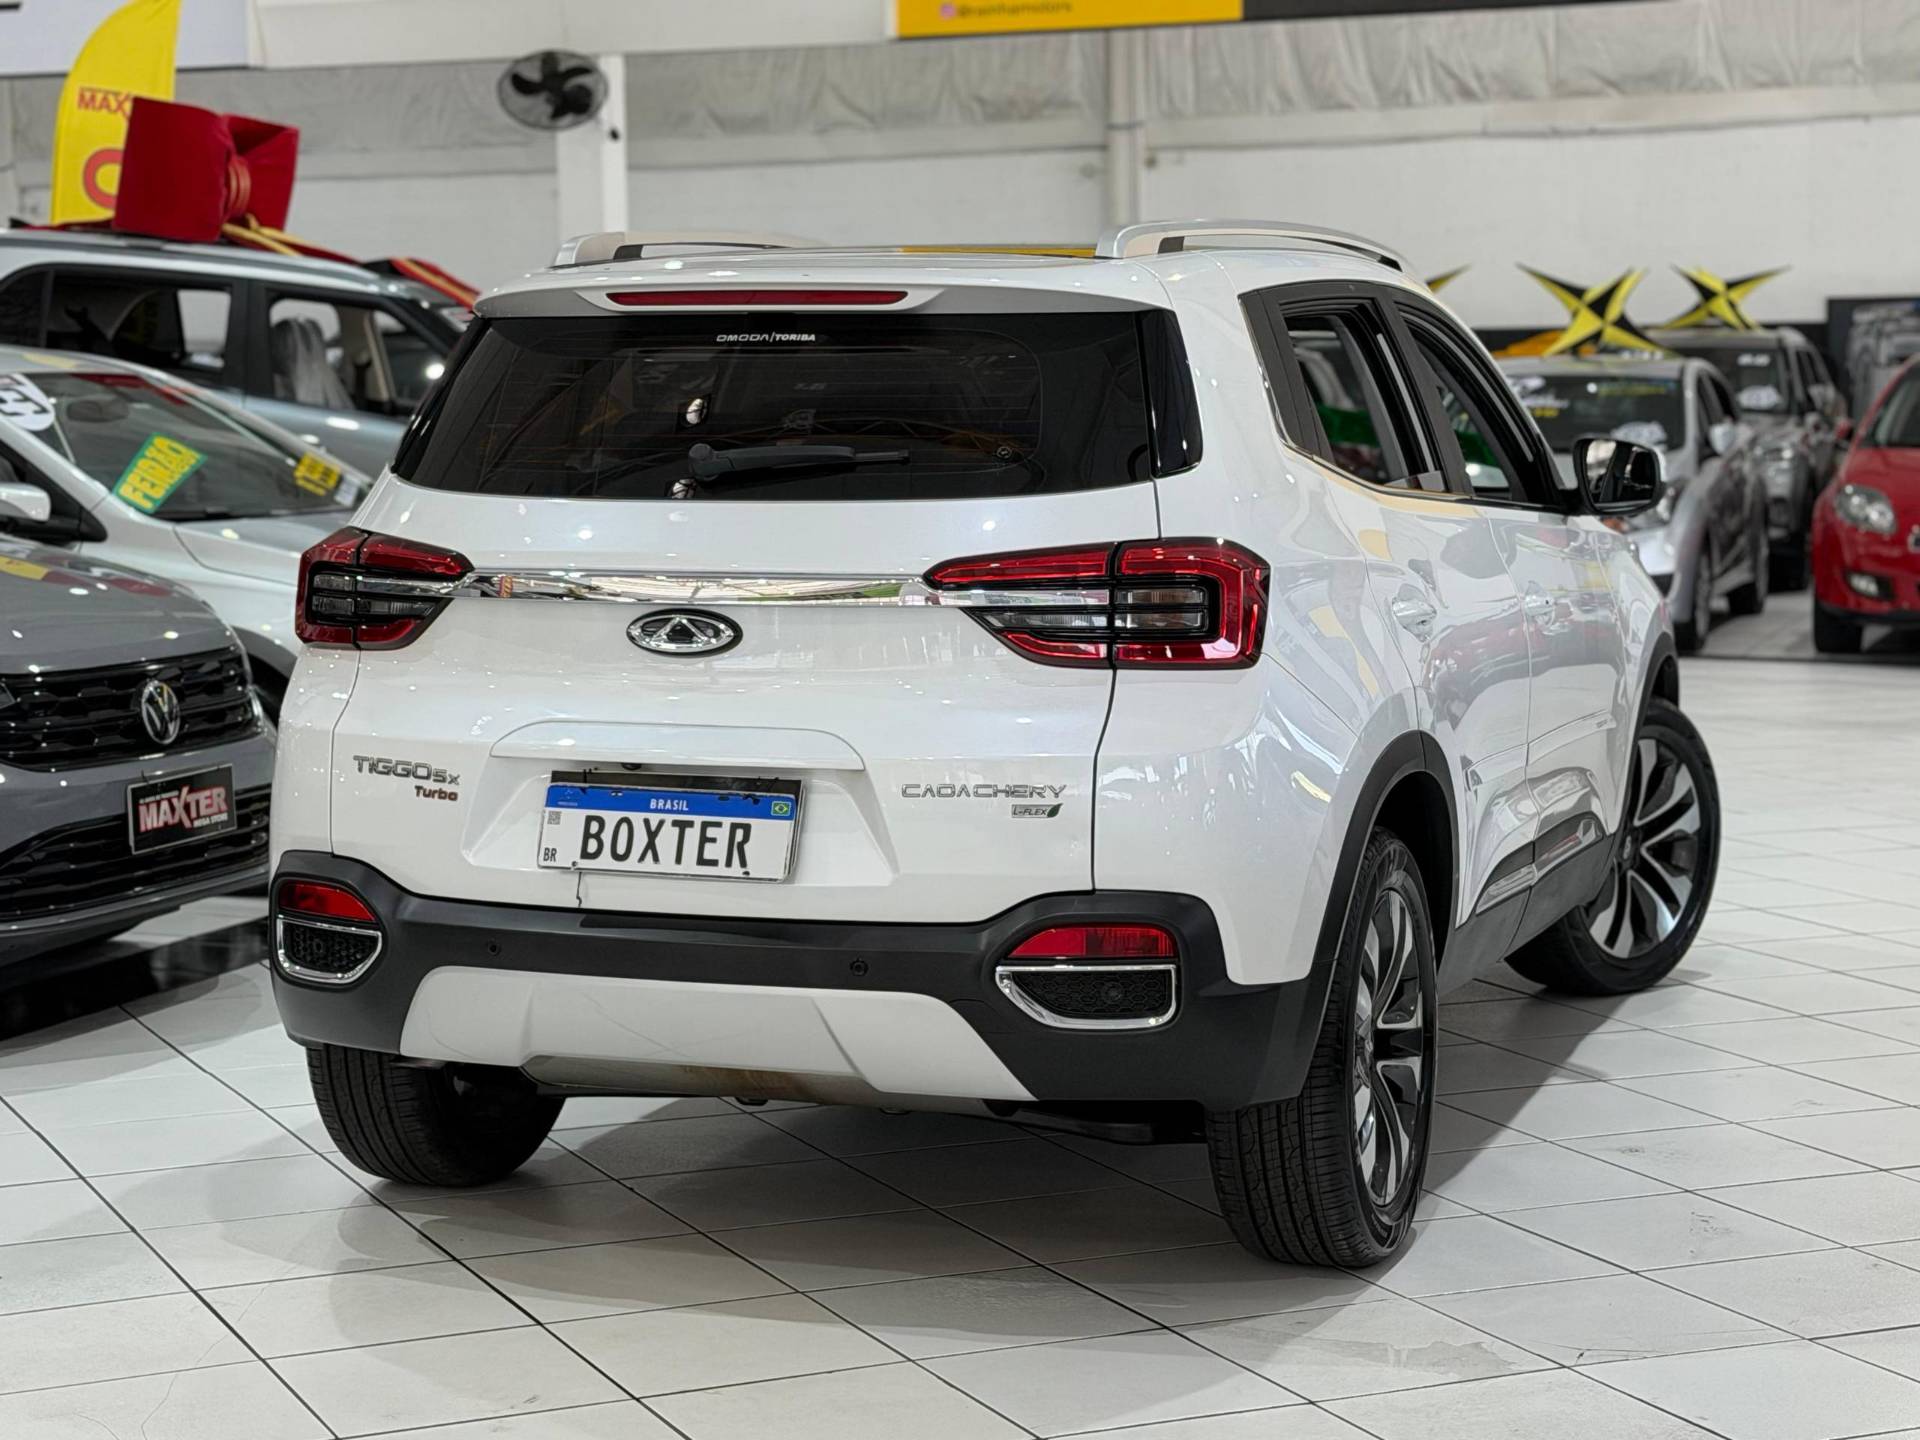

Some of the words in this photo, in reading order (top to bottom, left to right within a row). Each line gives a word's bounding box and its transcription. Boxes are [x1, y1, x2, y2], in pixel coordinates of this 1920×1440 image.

[77, 90, 132, 119] MAX
[414, 785, 459, 801] Turbo
[138, 786, 229, 832] MAXTER
[650, 798, 689, 811] BRASIL
[580, 814, 752, 868] BOXTER
[543, 847, 558, 862] BR
